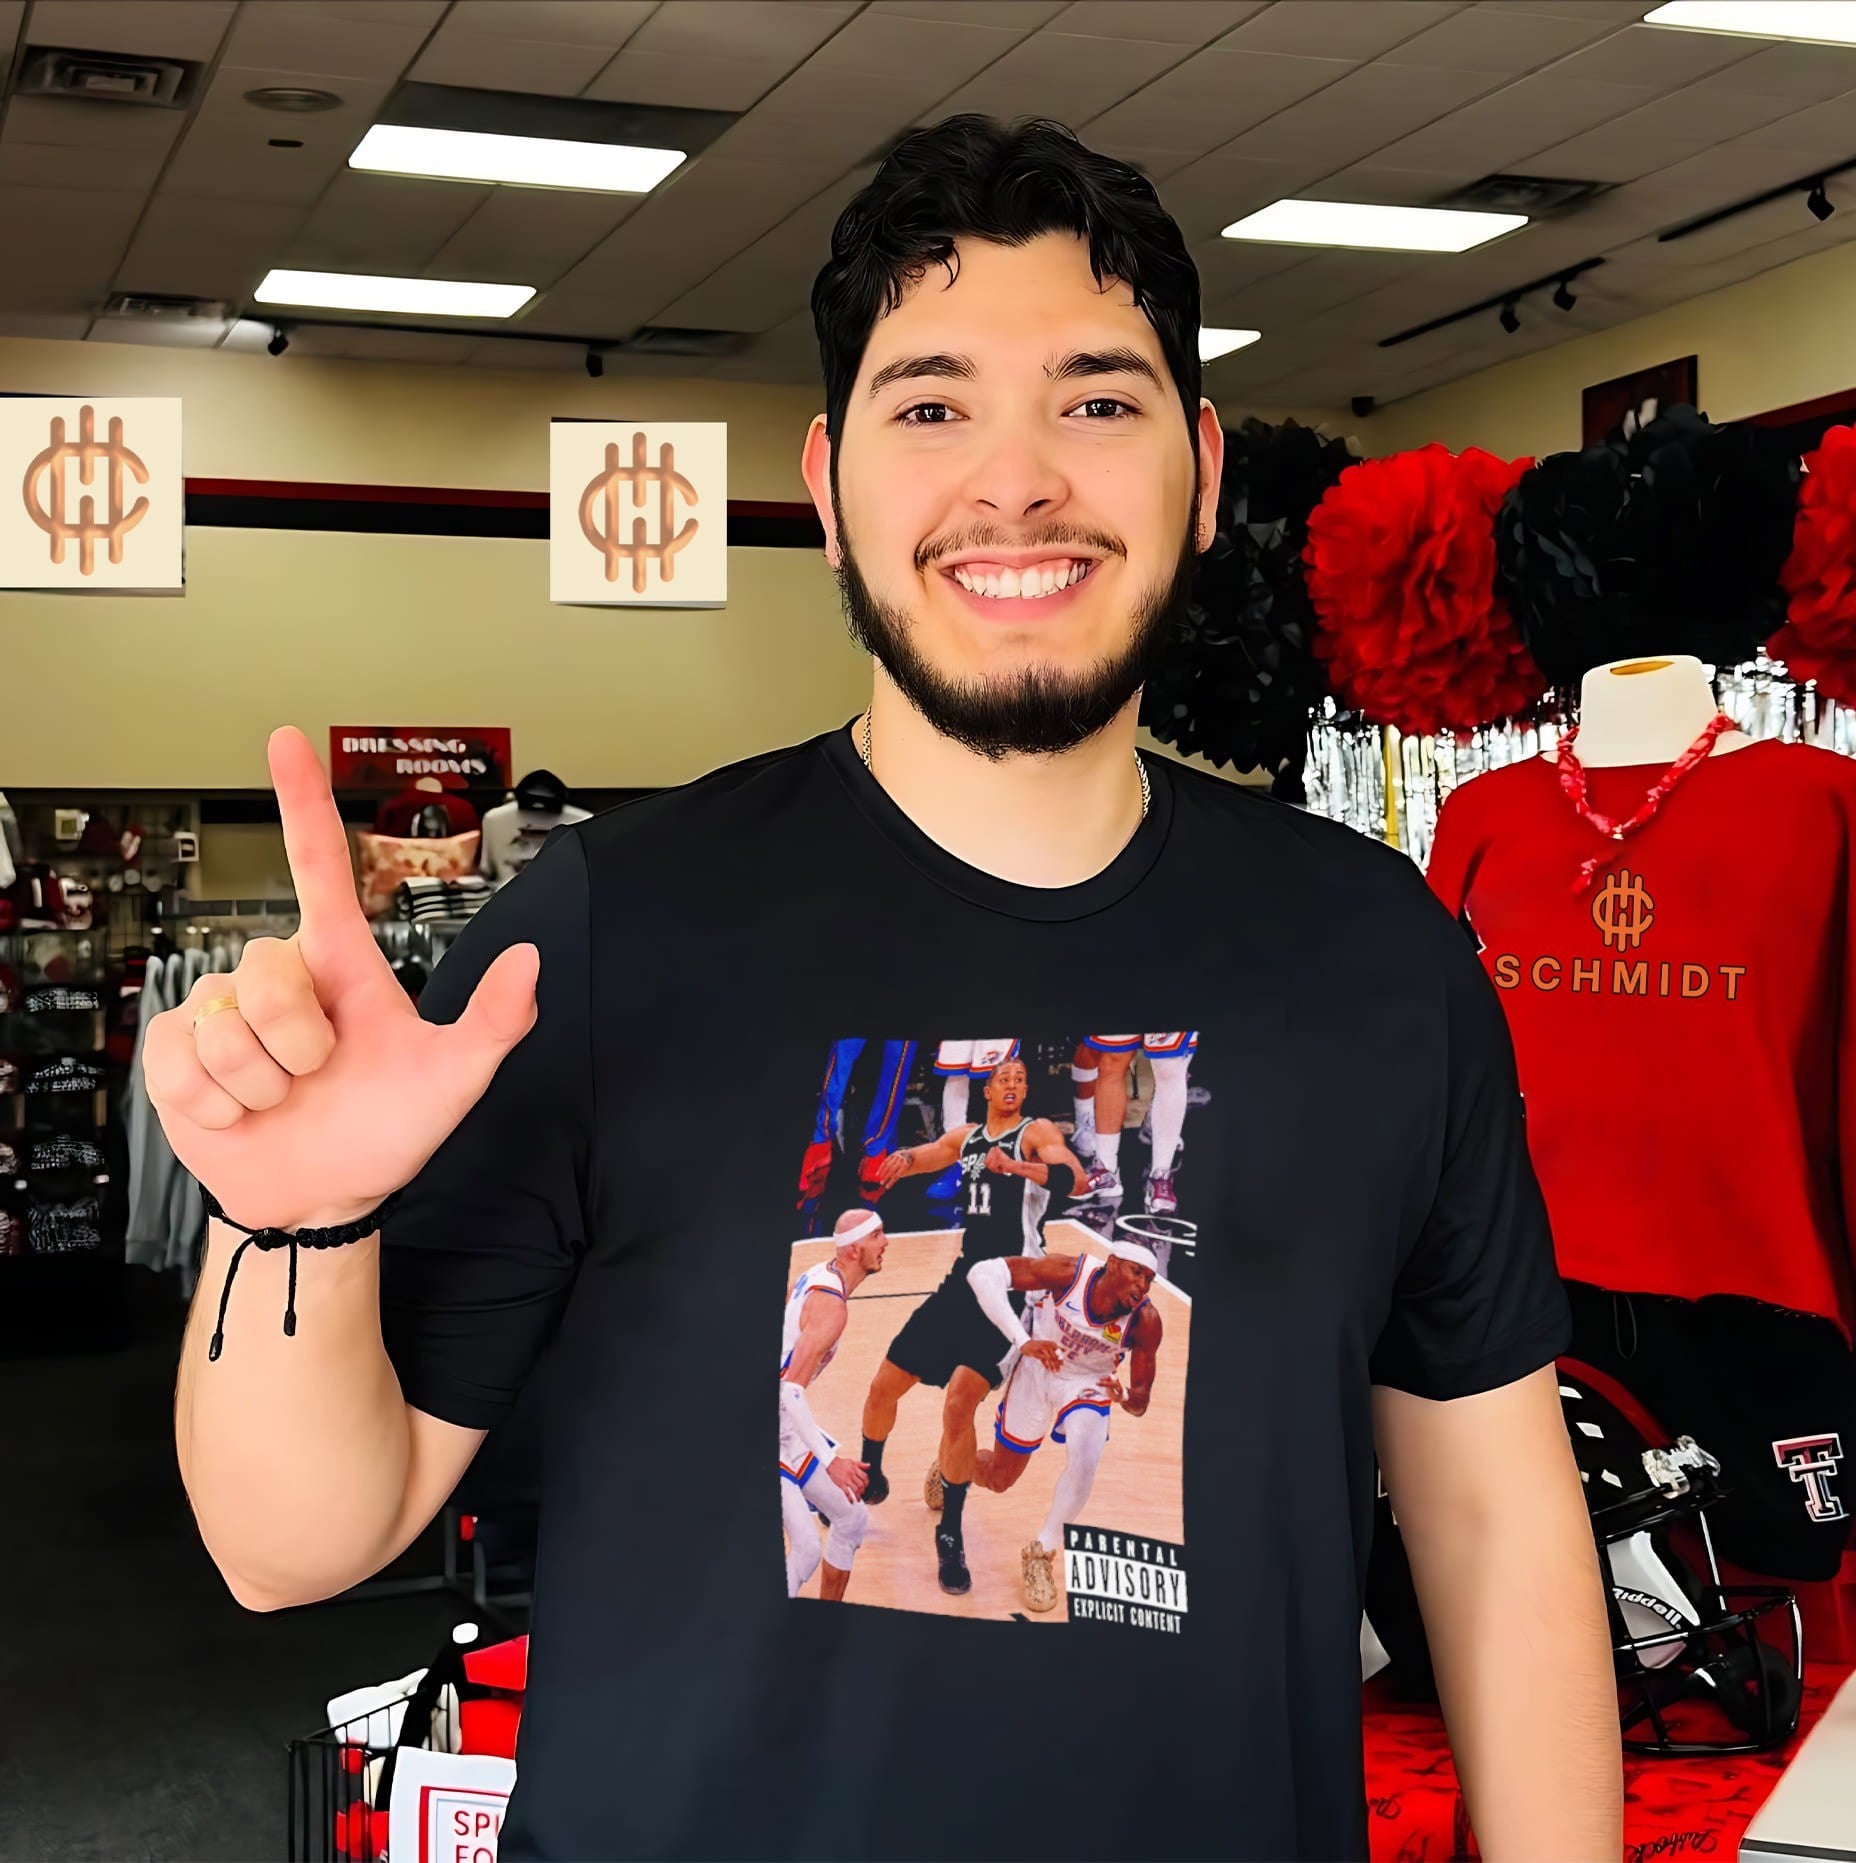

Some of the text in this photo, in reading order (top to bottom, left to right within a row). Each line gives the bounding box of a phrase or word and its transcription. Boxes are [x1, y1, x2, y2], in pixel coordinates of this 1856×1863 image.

[396, 758, 487, 774] ROOMS
[1494, 953, 1746, 1000] SCHMIDT
[967, 1183, 991, 1215] 11
[1069, 1530, 1177, 1567] PARENTAL
[1071, 1554, 1179, 1607] ADVISORY
[1073, 1598, 1181, 1634] EXPLICIT CONTENT
